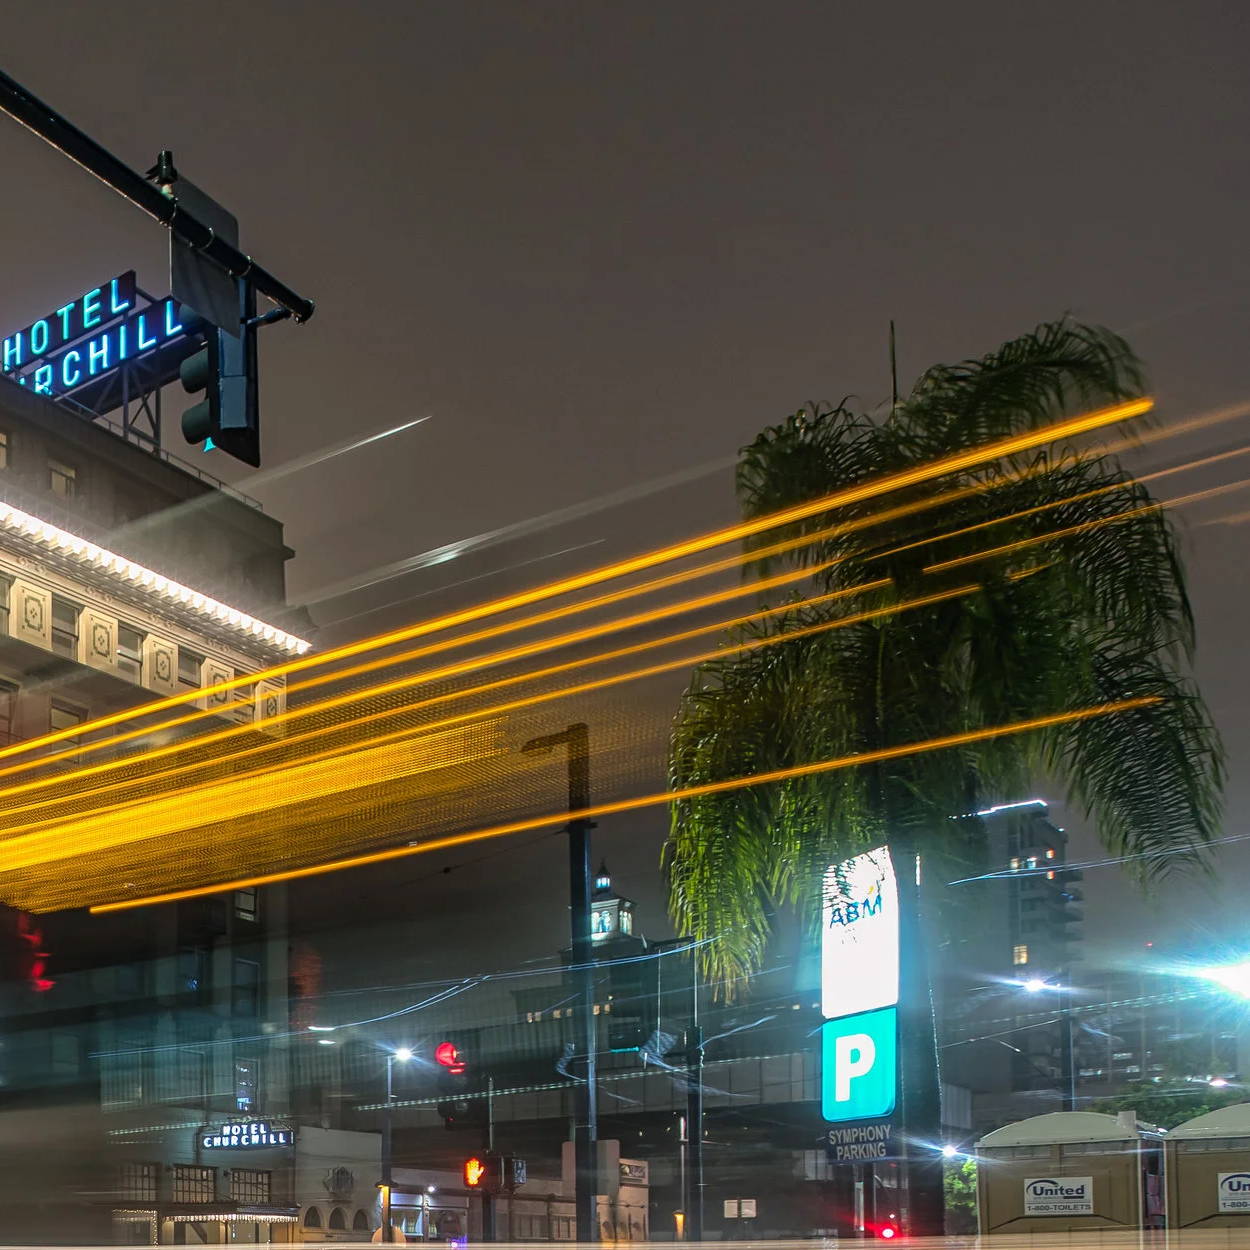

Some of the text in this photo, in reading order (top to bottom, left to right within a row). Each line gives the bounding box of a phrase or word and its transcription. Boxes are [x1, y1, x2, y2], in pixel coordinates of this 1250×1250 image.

[3, 278, 130, 371] HOTEL
[18, 300, 183, 396] RCHILL
[829, 894, 883, 930] ABM
[835, 1033, 877, 1103] P
[203, 1132, 287, 1148] CHURCHILL
[222, 1123, 267, 1136] HOTEL
[828, 1124, 892, 1146] SYMPHONY
[836, 1141, 887, 1162] PARKING
[1032, 1184, 1085, 1196] United
[1027, 1203, 1092, 1212] 1-800-TOILETS
